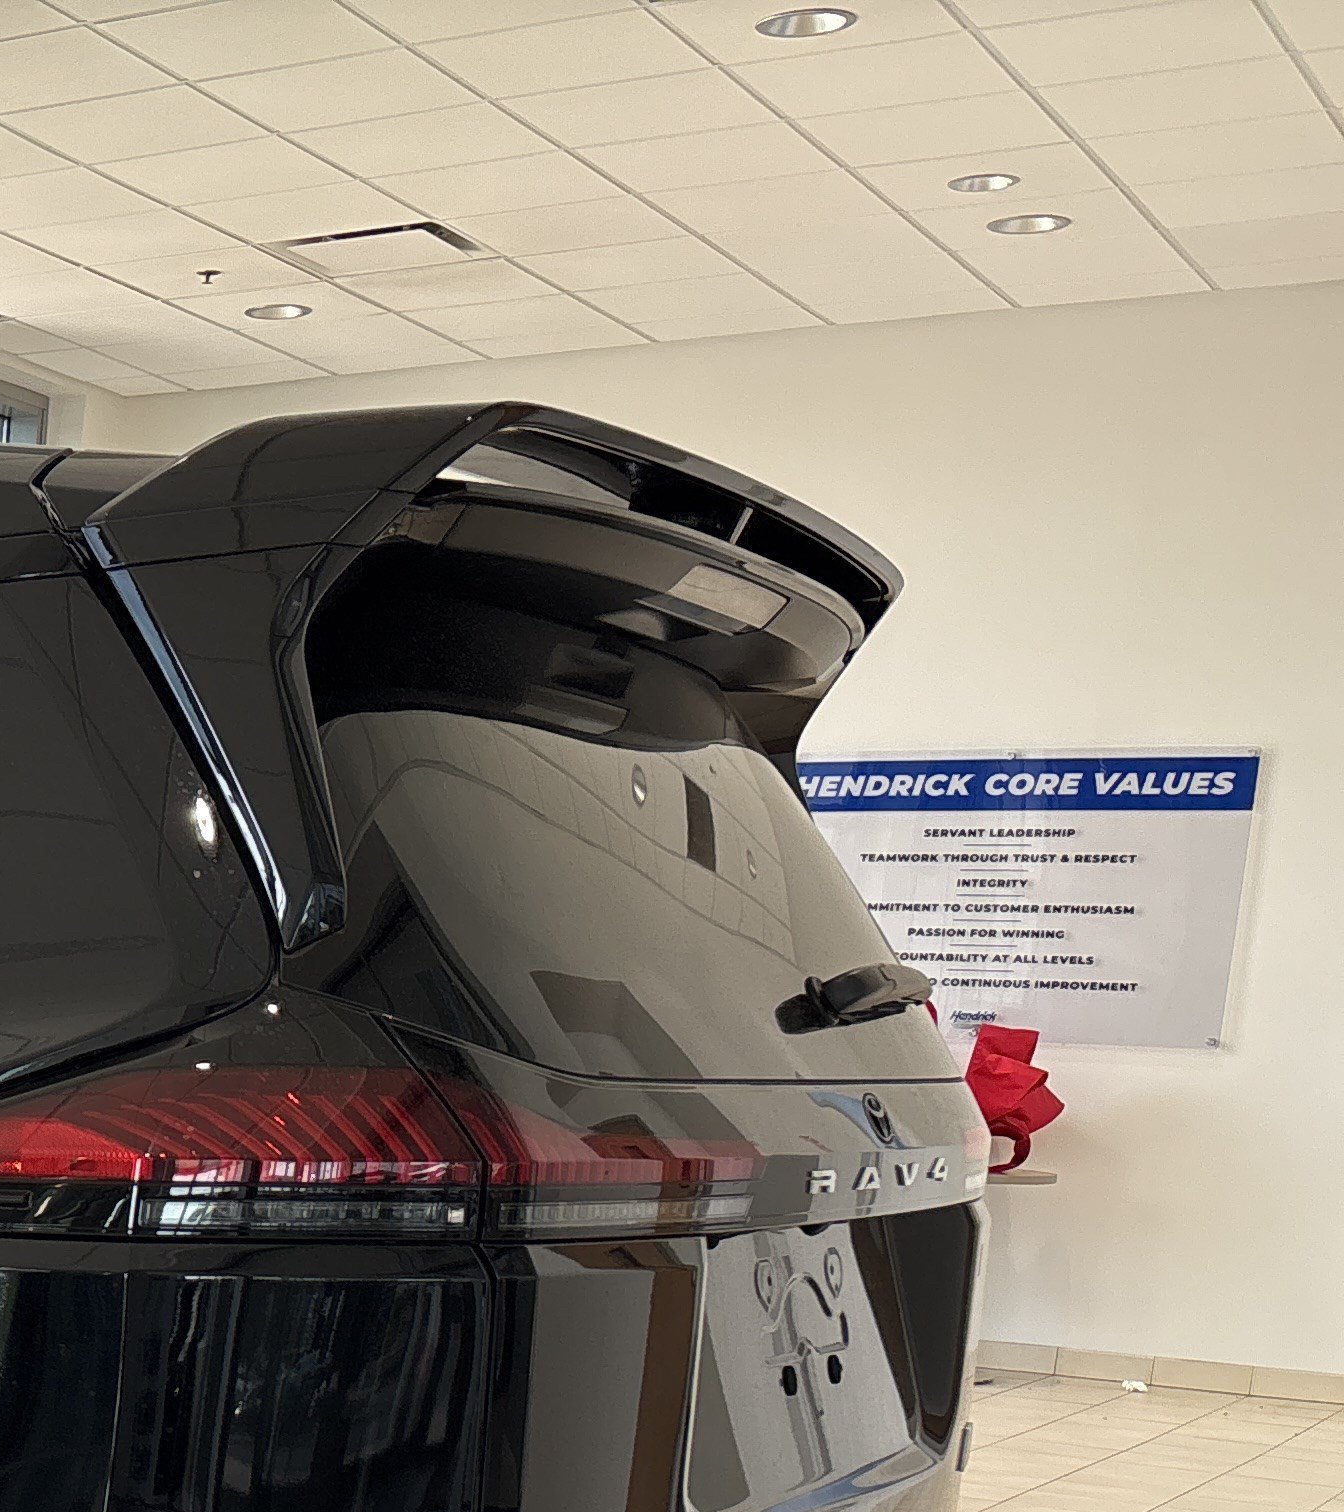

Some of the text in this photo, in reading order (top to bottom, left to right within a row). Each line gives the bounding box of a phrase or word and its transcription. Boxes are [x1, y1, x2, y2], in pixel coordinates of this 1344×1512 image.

[798, 772, 1236, 797] HENDRICK CORE VALUES
[923, 829, 1076, 838] SERVANT LEADERSHIP
[860, 853, 1137, 864] TEAMWORK THROUGH TRUST & RESPECT
[956, 878, 1029, 888] INTEGRITY
[867, 902, 1135, 914] MMITMENT TO CUSTOMER ENTHUSIASM
[907, 927, 1065, 939] PASSION FOR WINNING
[895, 952, 1094, 965] OUNTABILITY AT ALL LEVELS
[942, 978, 1030, 988] CONTINUOUS
[1034, 979, 1139, 991] IMPROVEMENT
[950, 1010, 998, 1023] Hendrick
[806, 1157, 948, 1194] RAV4
